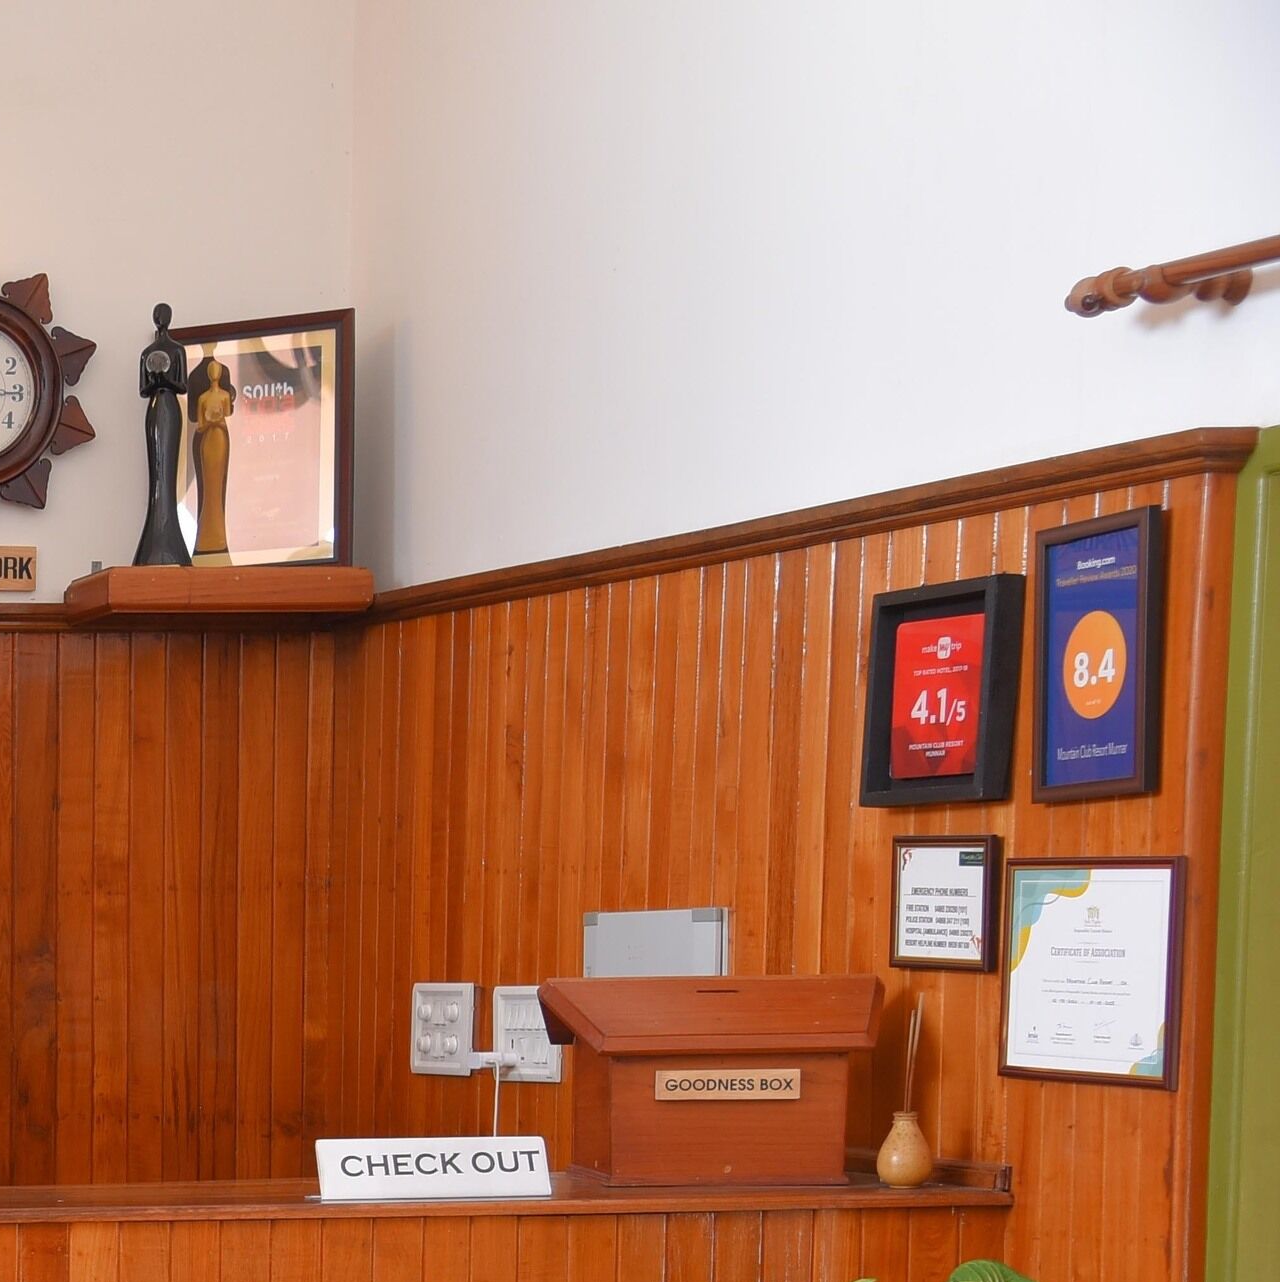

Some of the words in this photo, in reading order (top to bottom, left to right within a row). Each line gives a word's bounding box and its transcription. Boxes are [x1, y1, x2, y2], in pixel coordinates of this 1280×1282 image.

[6, 358, 16, 375] 2
[12, 384, 24, 402] 3
[2, 411, 14, 429] 4
[1077, 556, 1116, 570] Booking.com
[1073, 648, 1116, 689] 8.4
[911, 688, 966, 726] 4.1/5
[911, 887, 934, 896] EMERGENCY
[935, 888, 948, 896] PHONE
[664, 1077, 755, 1092] GOODNESS
[759, 1078, 794, 1091] BOX
[339, 1152, 465, 1177] CHECK
[470, 1150, 540, 1173] OUT
